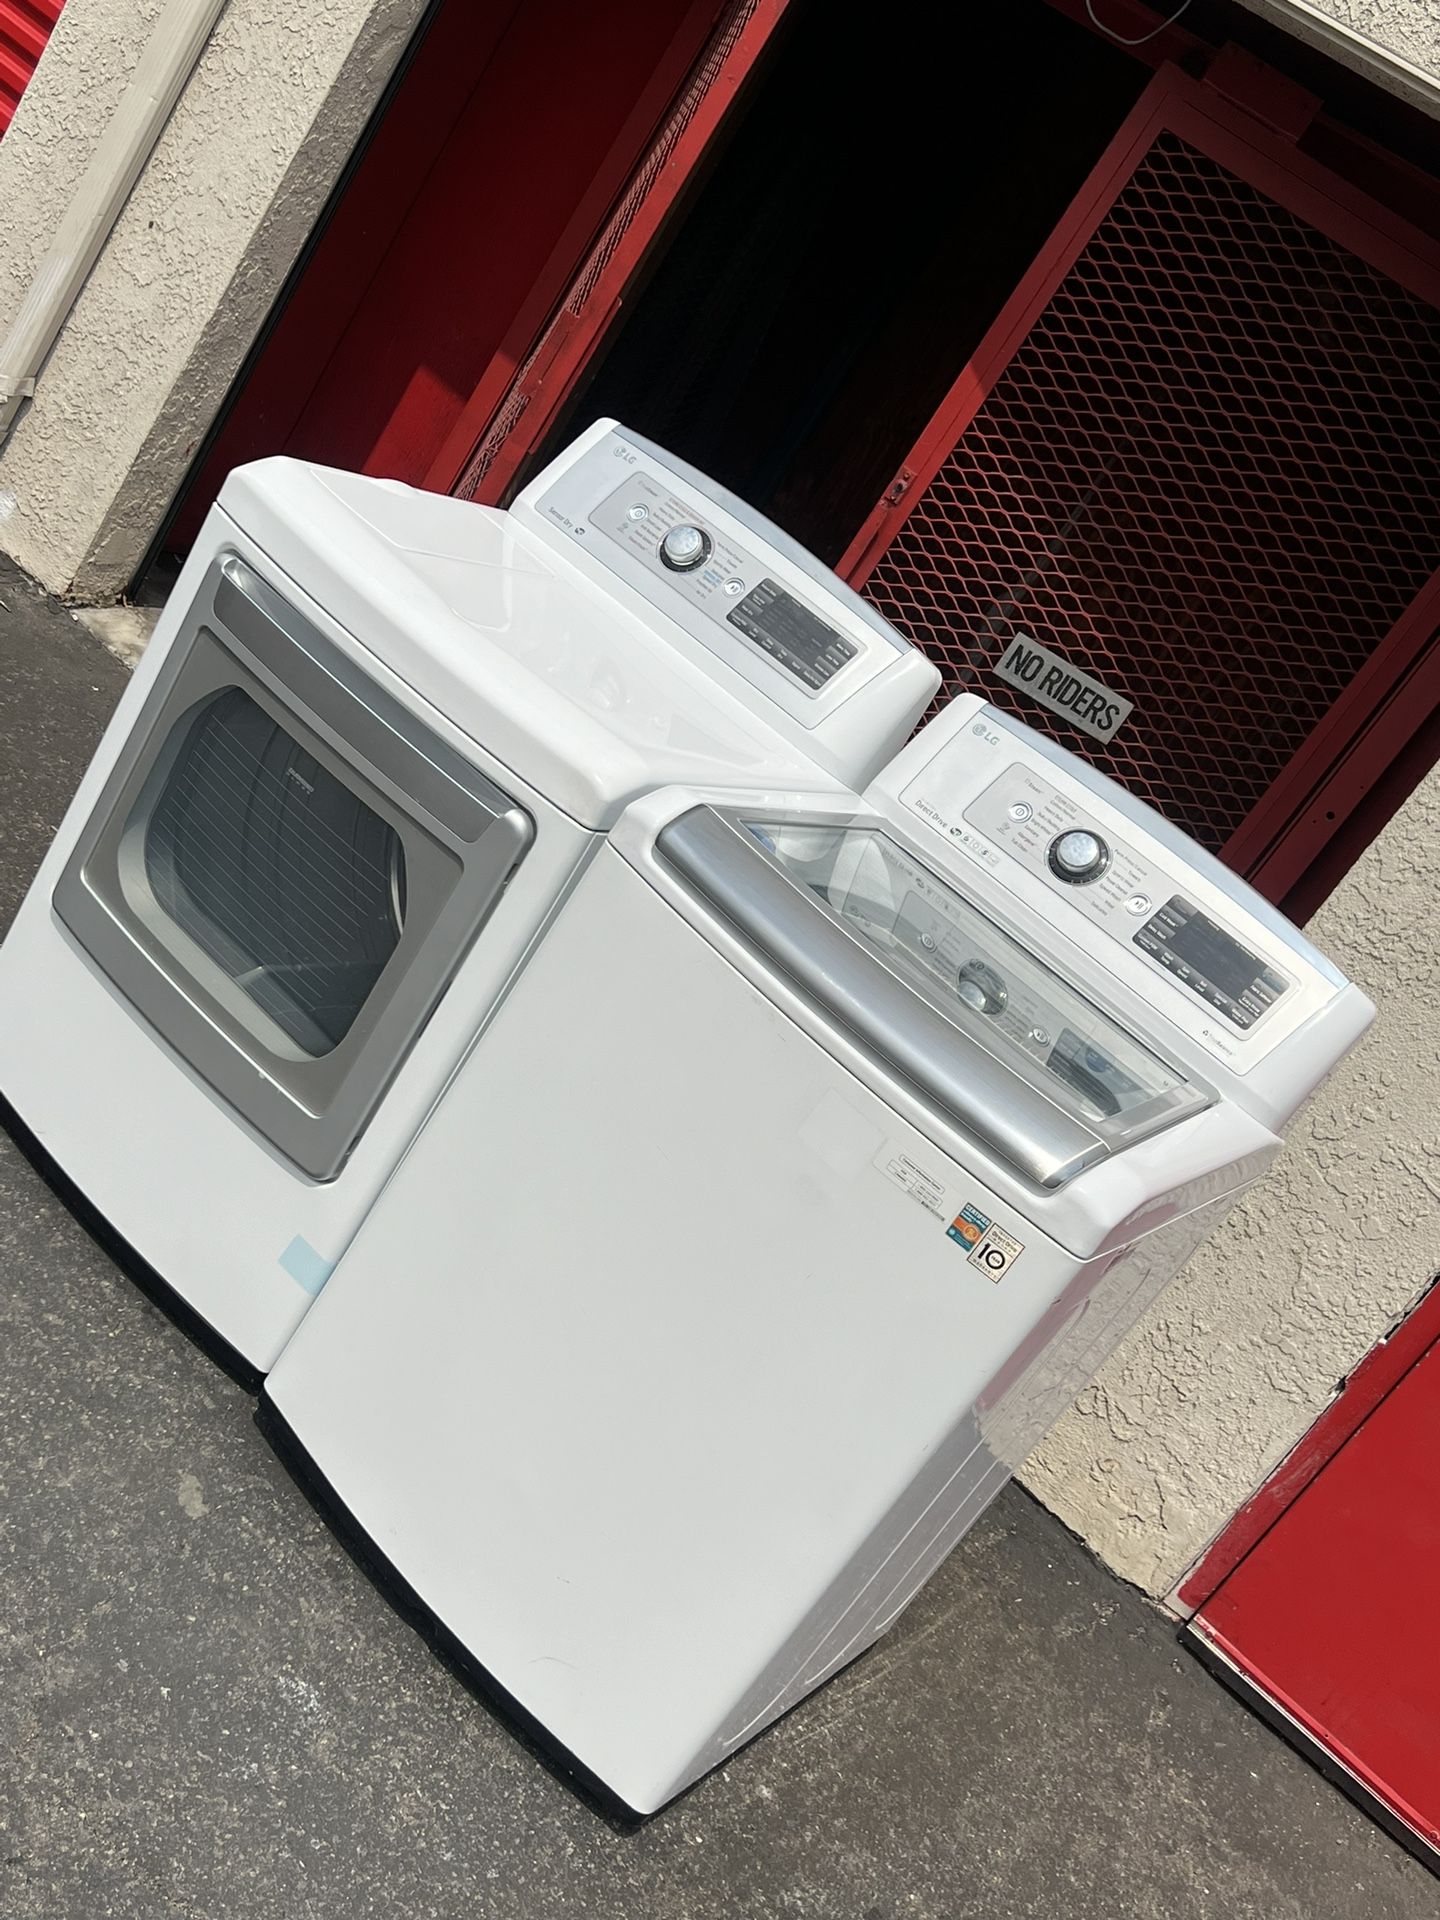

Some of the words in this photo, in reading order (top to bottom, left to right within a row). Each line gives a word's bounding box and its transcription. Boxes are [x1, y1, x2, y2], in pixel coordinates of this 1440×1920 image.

[547, 506, 565, 521] Sensor
[562, 517, 574, 529] Dry
[1004, 644, 1041, 683] NO
[1038, 668, 1121, 732] RIDERS
[983, 730, 1000, 746] LG
[914, 799, 934, 816] Direct
[930, 812, 949, 828] Drive
[964, 1204, 991, 1226] CERTIFIED
[991, 1230, 1006, 1243] Direct
[1004, 1241, 1017, 1252] Drive
[977, 1241, 1008, 1271] 10
